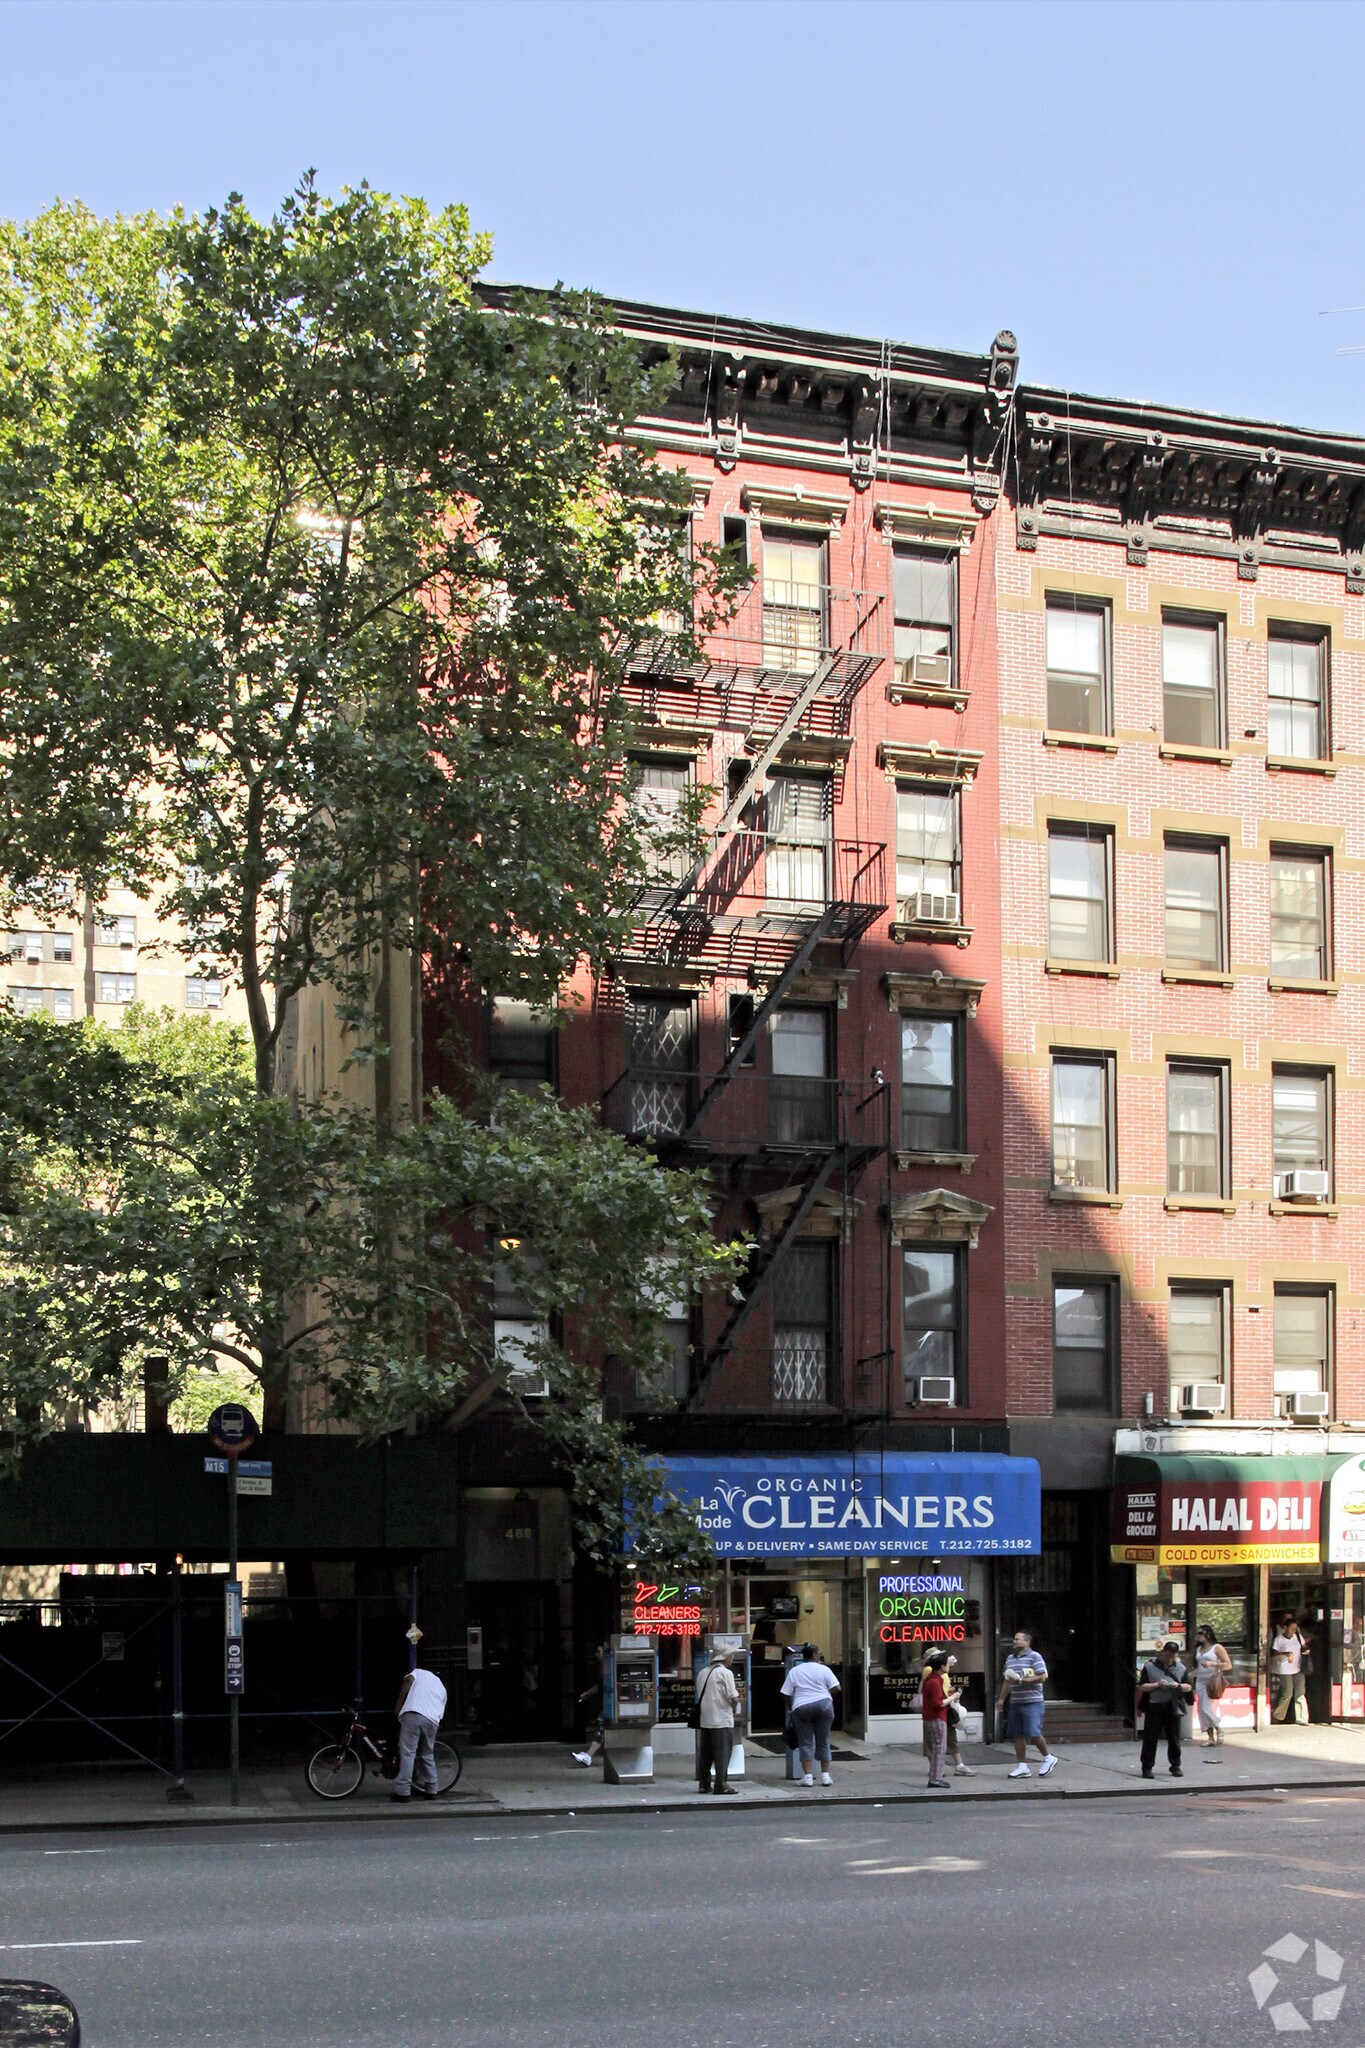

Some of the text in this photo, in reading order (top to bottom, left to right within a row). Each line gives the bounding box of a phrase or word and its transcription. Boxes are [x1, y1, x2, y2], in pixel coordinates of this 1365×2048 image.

[206, 1462, 225, 1472] M15
[757, 1478, 864, 1492] ORGANIC
[700, 1496, 718, 1510] La
[1127, 1496, 1156, 1505] HALAL
[742, 1495, 995, 1529] CLEANERS
[1128, 1511, 1155, 1523] DELI &
[1171, 1496, 1311, 1532] HALAL DELI
[1126, 1525, 1157, 1536] GROCERY
[715, 1541, 732, 1551] UP
[735, 1541, 745, 1551] &
[747, 1541, 805, 1551] DELIVERY
[817, 1541, 852, 1551] SAME
[854, 1541, 876, 1551] DAY
[879, 1540, 928, 1551] SERVICE
[939, 1539, 1032, 1550] T.212.725.3182
[1165, 1547, 1315, 1561] COLD CUTS SANDWICHES
[879, 1575, 965, 1593] PROFESSIONAL
[634, 1605, 701, 1620] CLEANERS
[879, 1596, 966, 1617] ORGANIC
[634, 1622, 701, 1637] 212-725-3182
[879, 1624, 966, 1643] CLEANING
[883, 1676, 919, 1686] Expert
